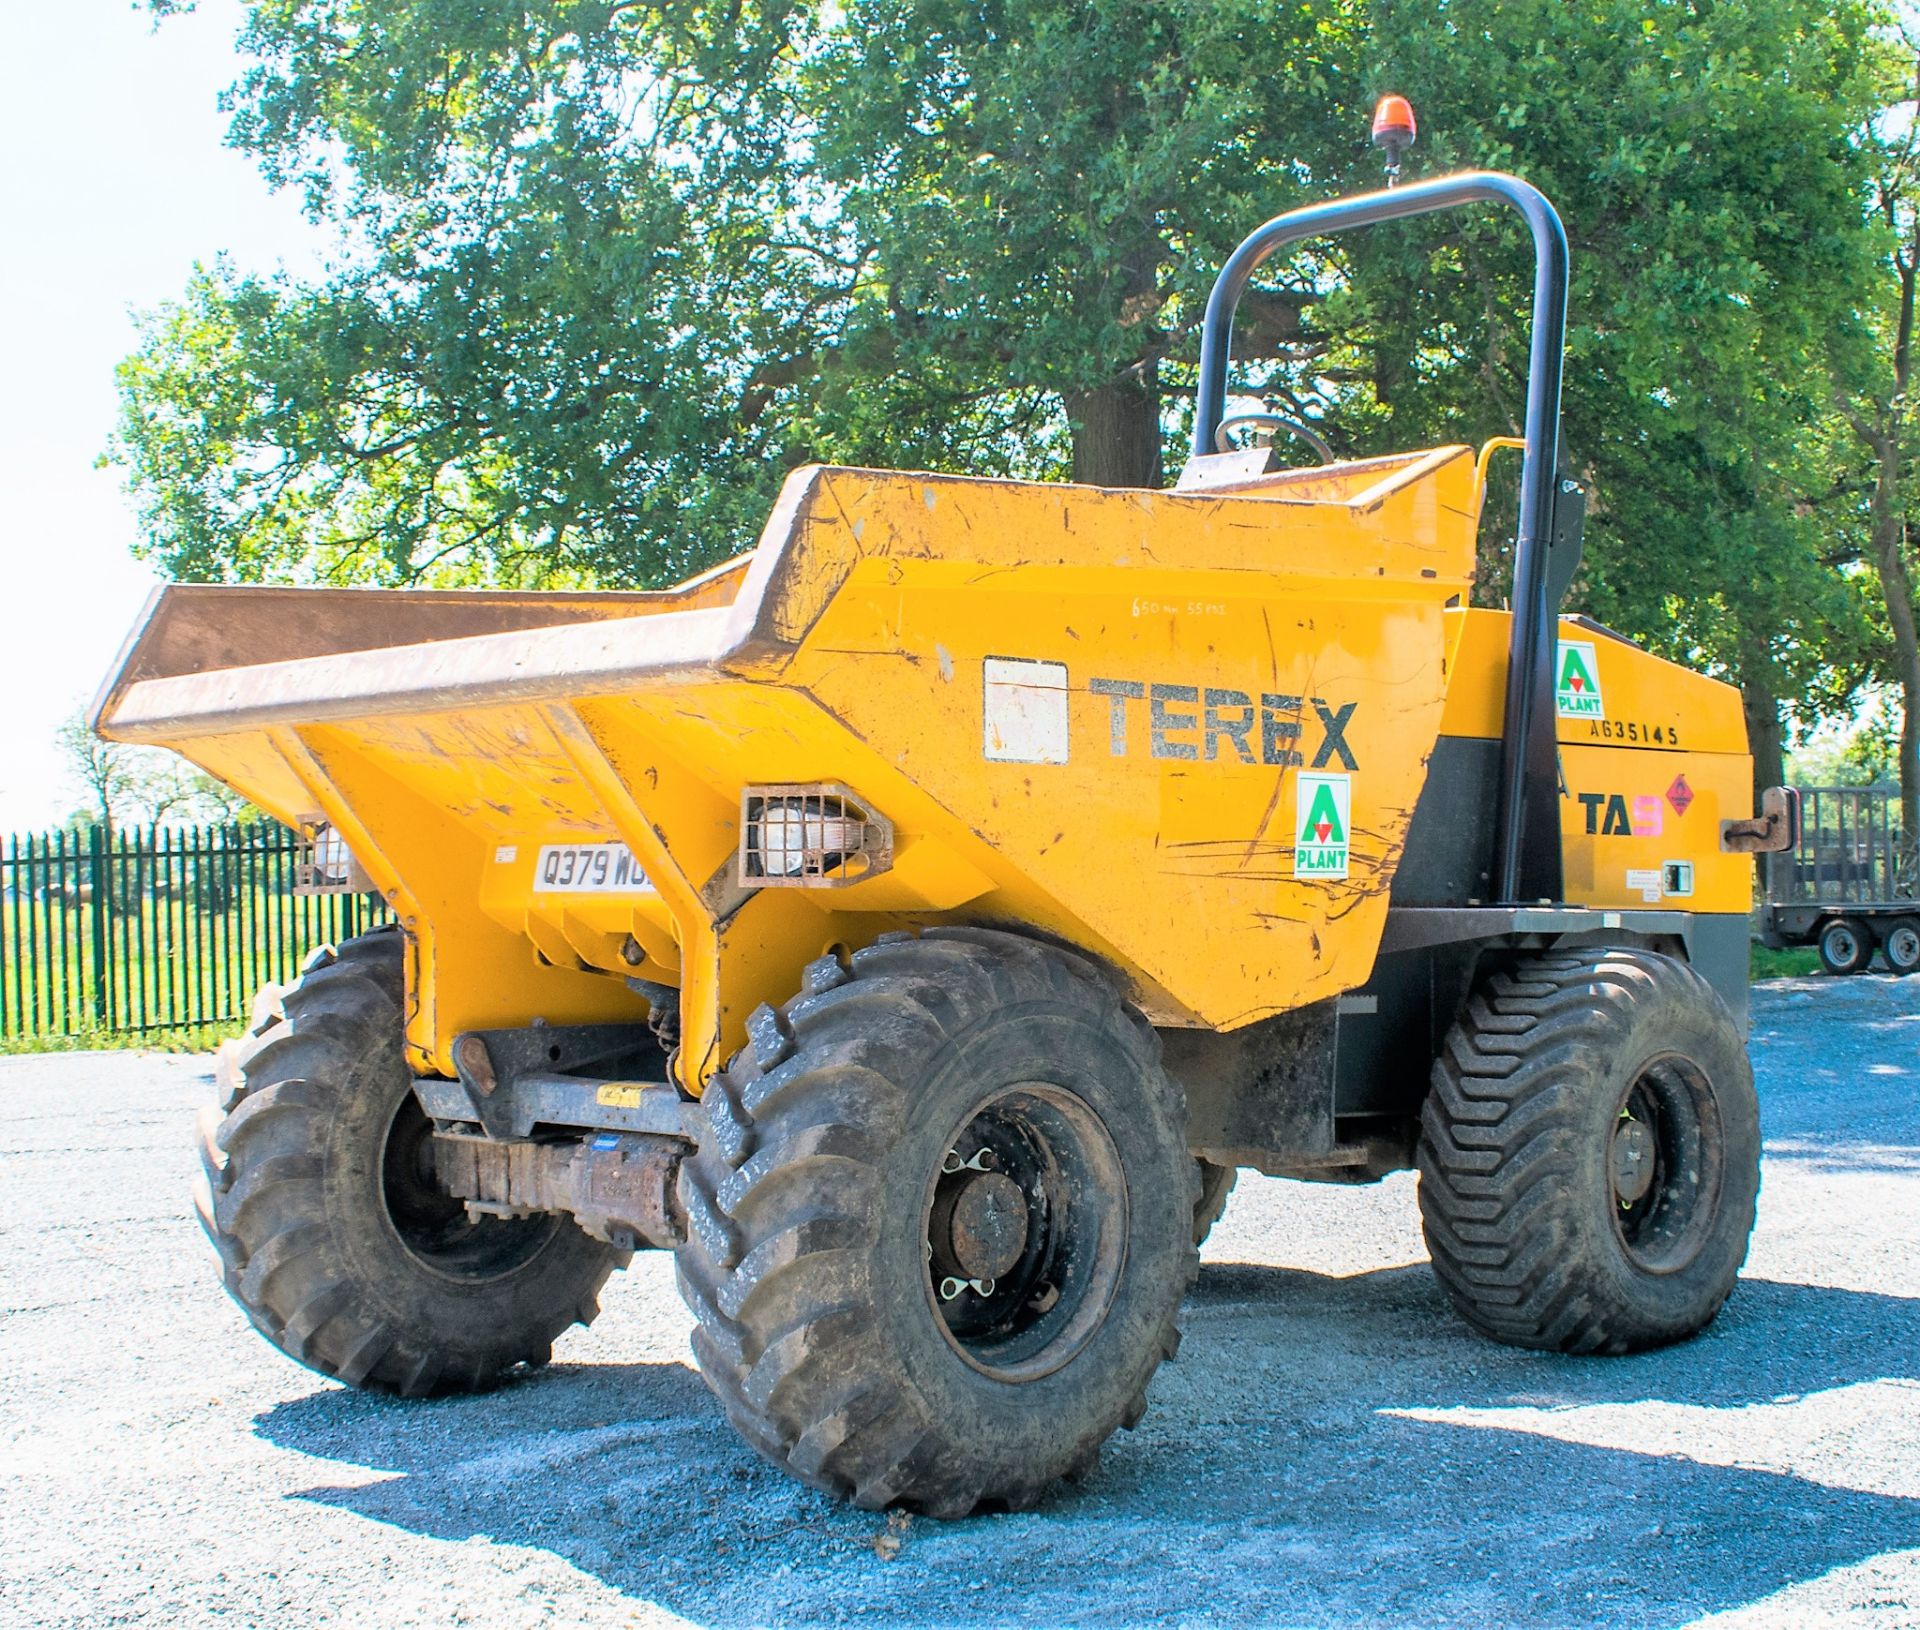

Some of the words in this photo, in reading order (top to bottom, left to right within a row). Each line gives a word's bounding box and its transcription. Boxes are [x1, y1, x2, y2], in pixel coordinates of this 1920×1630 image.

[1132, 598, 1160, 617] 650
[1187, 602, 1203, 615] 55
[1558, 696, 1600, 712] PLANT
[1089, 678, 1359, 771] TEREX
[1591, 719, 1678, 745] A635145
[1578, 793, 1663, 836] TA9
[544, 850, 609, 885] Q379
[1297, 850, 1346, 868] PLANT
